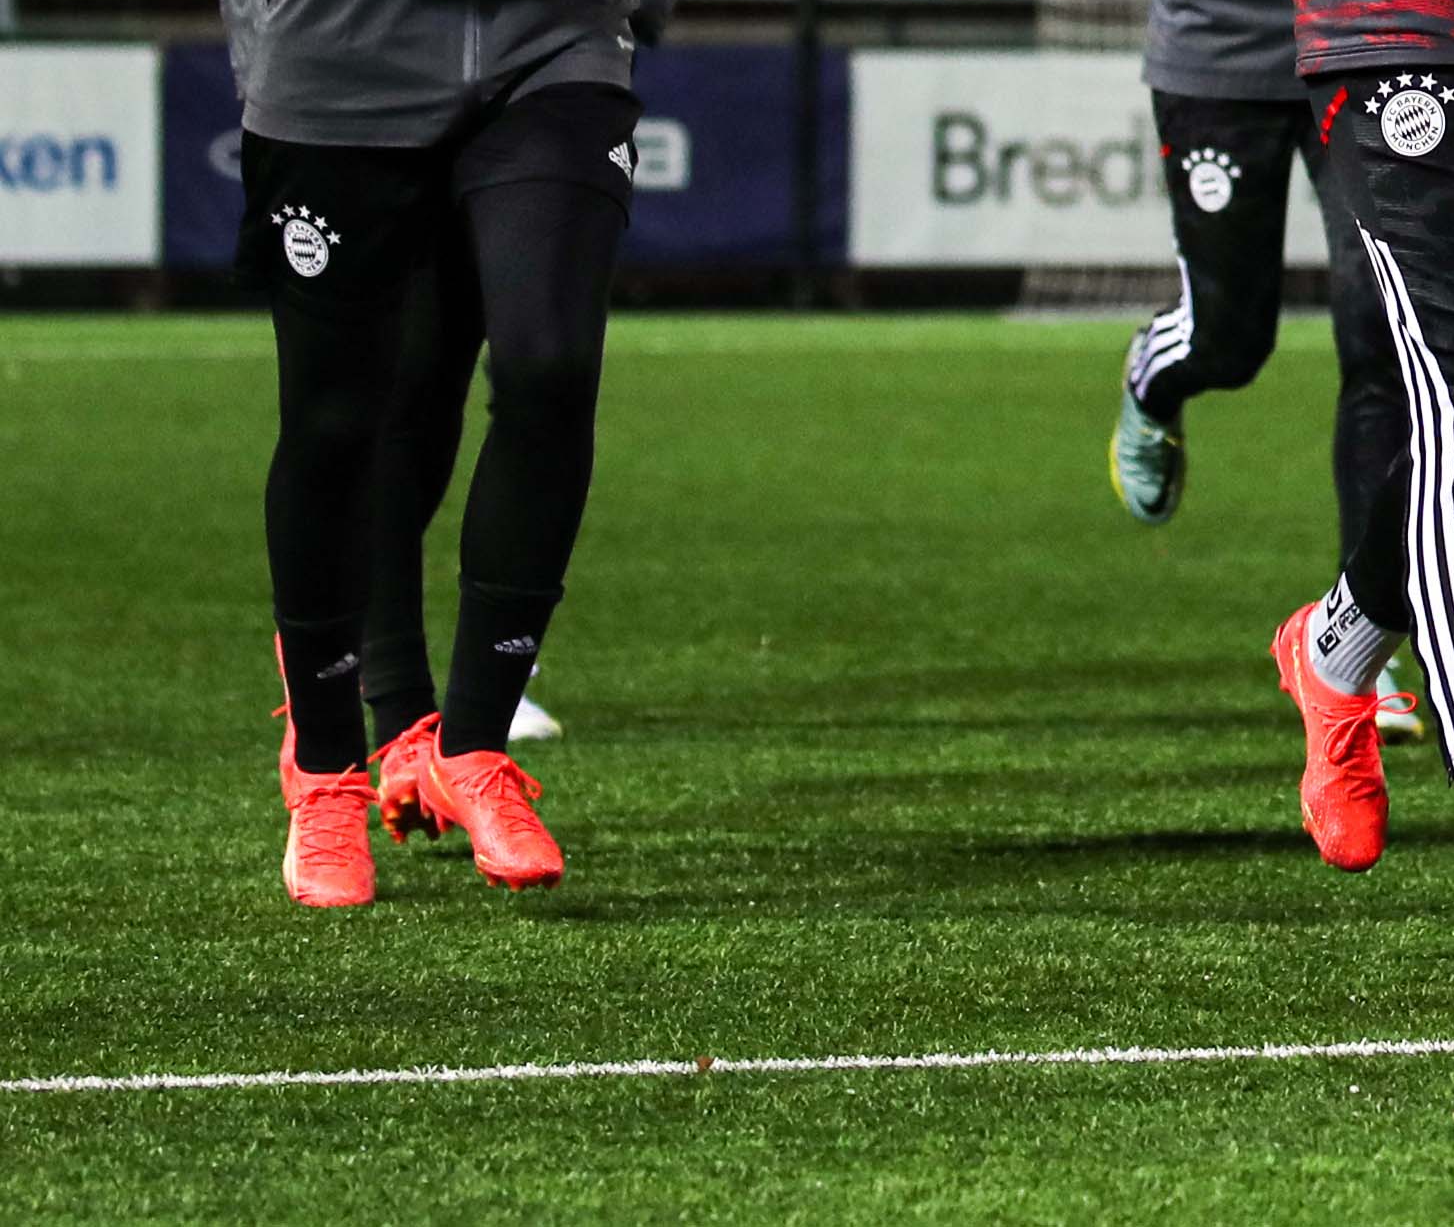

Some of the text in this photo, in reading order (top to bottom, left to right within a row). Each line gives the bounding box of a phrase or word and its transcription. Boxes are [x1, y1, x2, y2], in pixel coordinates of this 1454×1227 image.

[1387, 96, 1437, 121] FC BAYERN
[932, 109, 1170, 208] Bred
